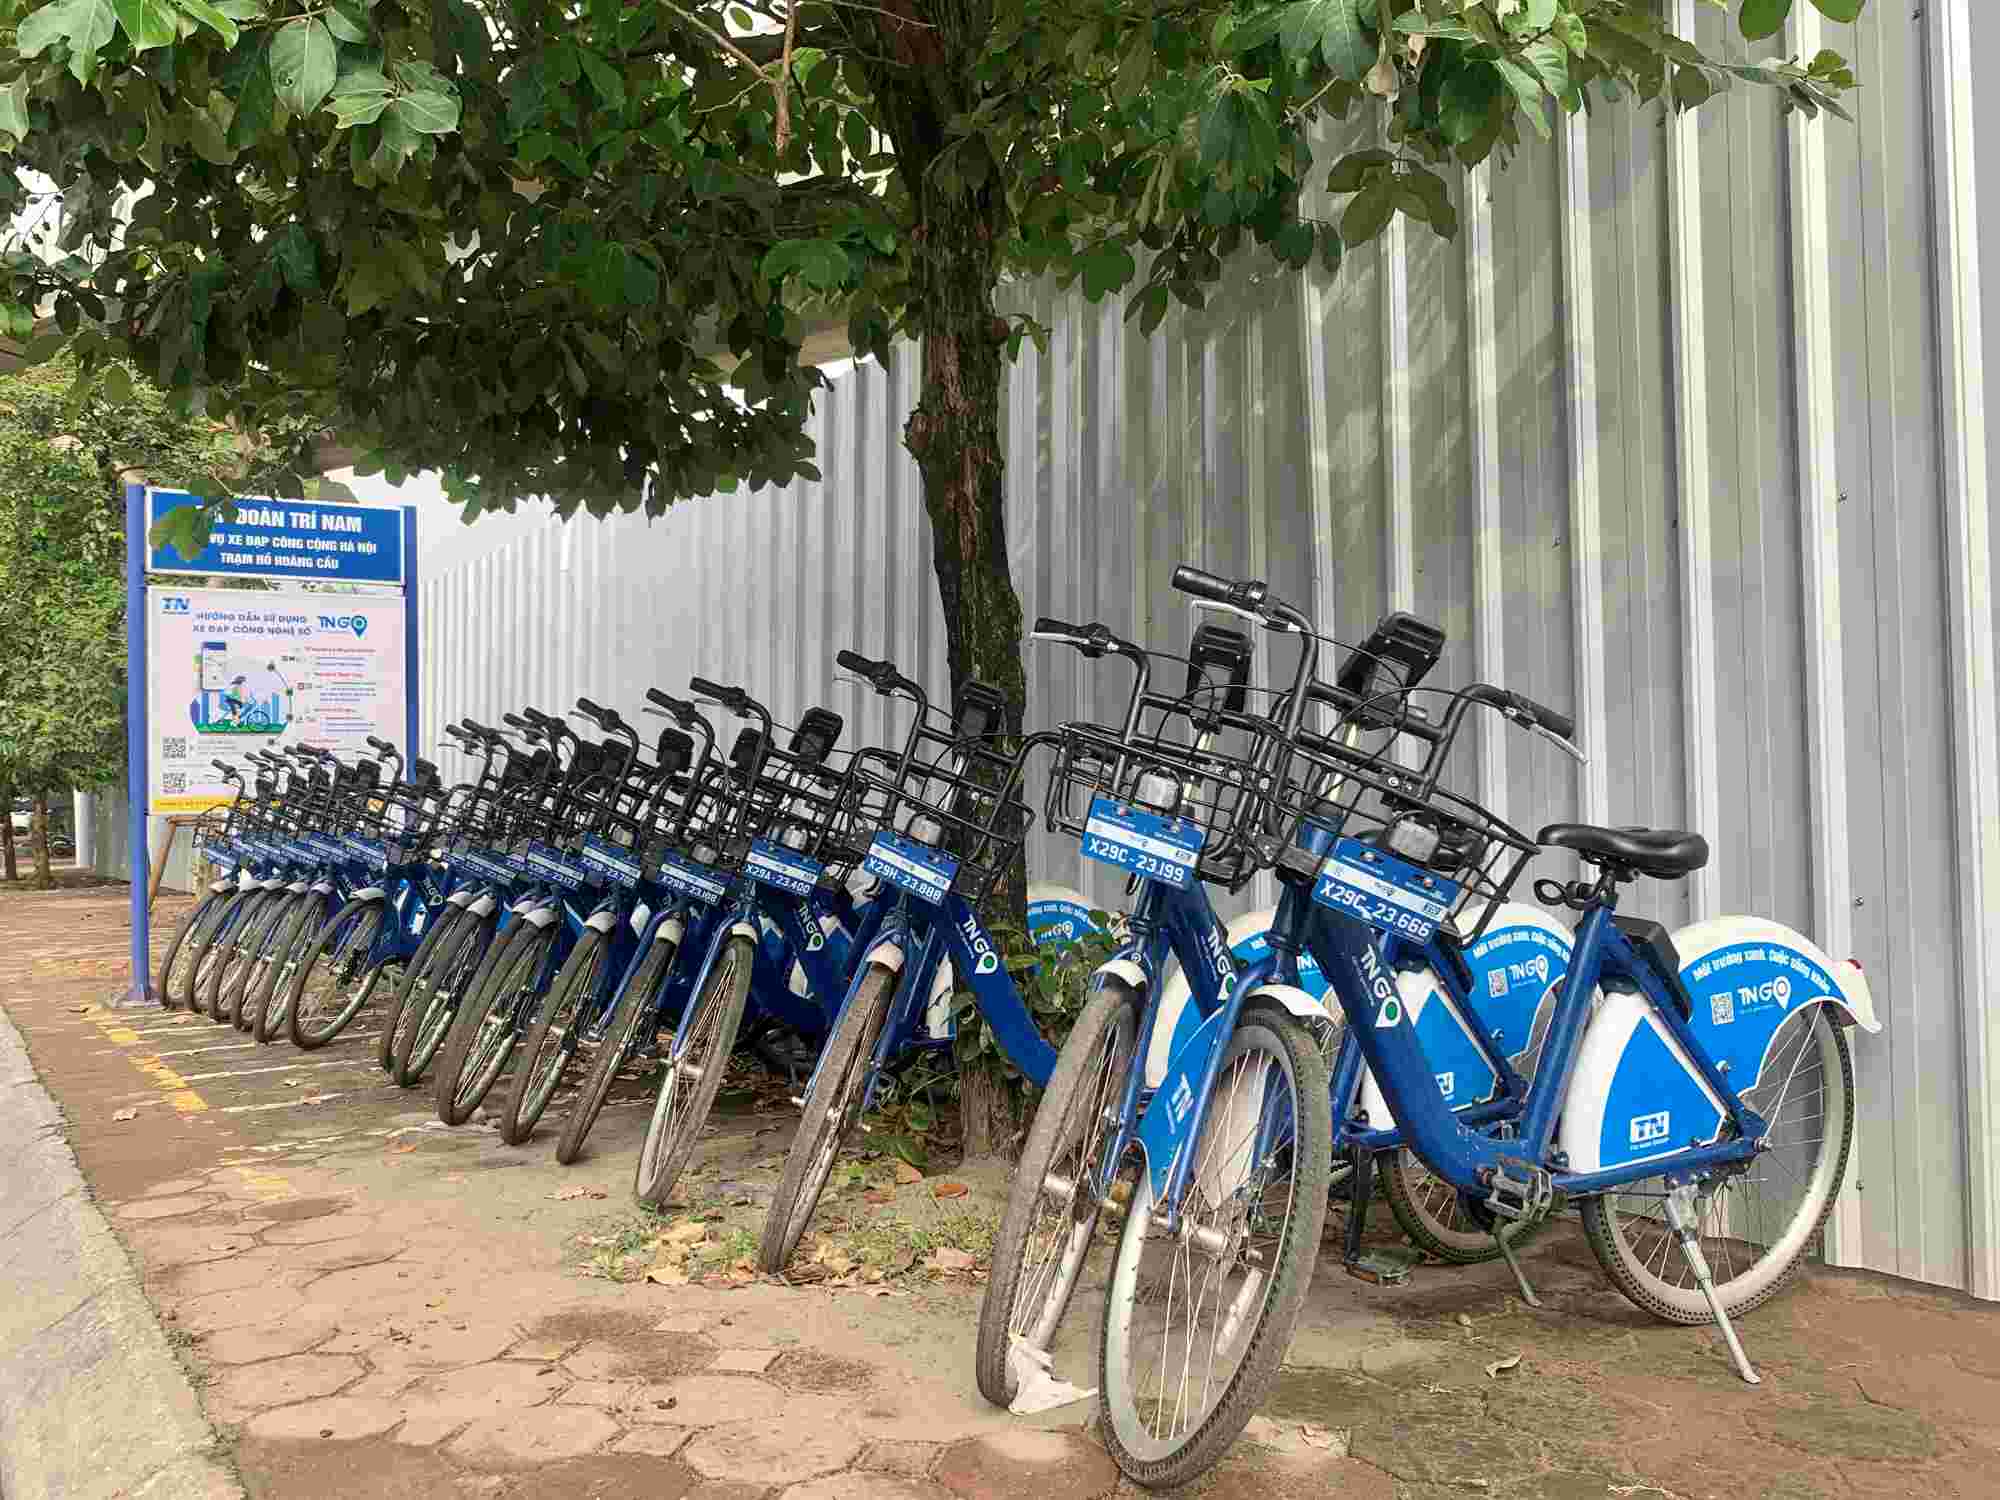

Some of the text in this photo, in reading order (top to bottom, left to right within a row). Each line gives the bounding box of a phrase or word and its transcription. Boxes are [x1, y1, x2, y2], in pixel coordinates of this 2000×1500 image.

[321, 513, 362, 532] NAM
[228, 533, 243, 545] XE
[162, 597, 191, 610] TN
